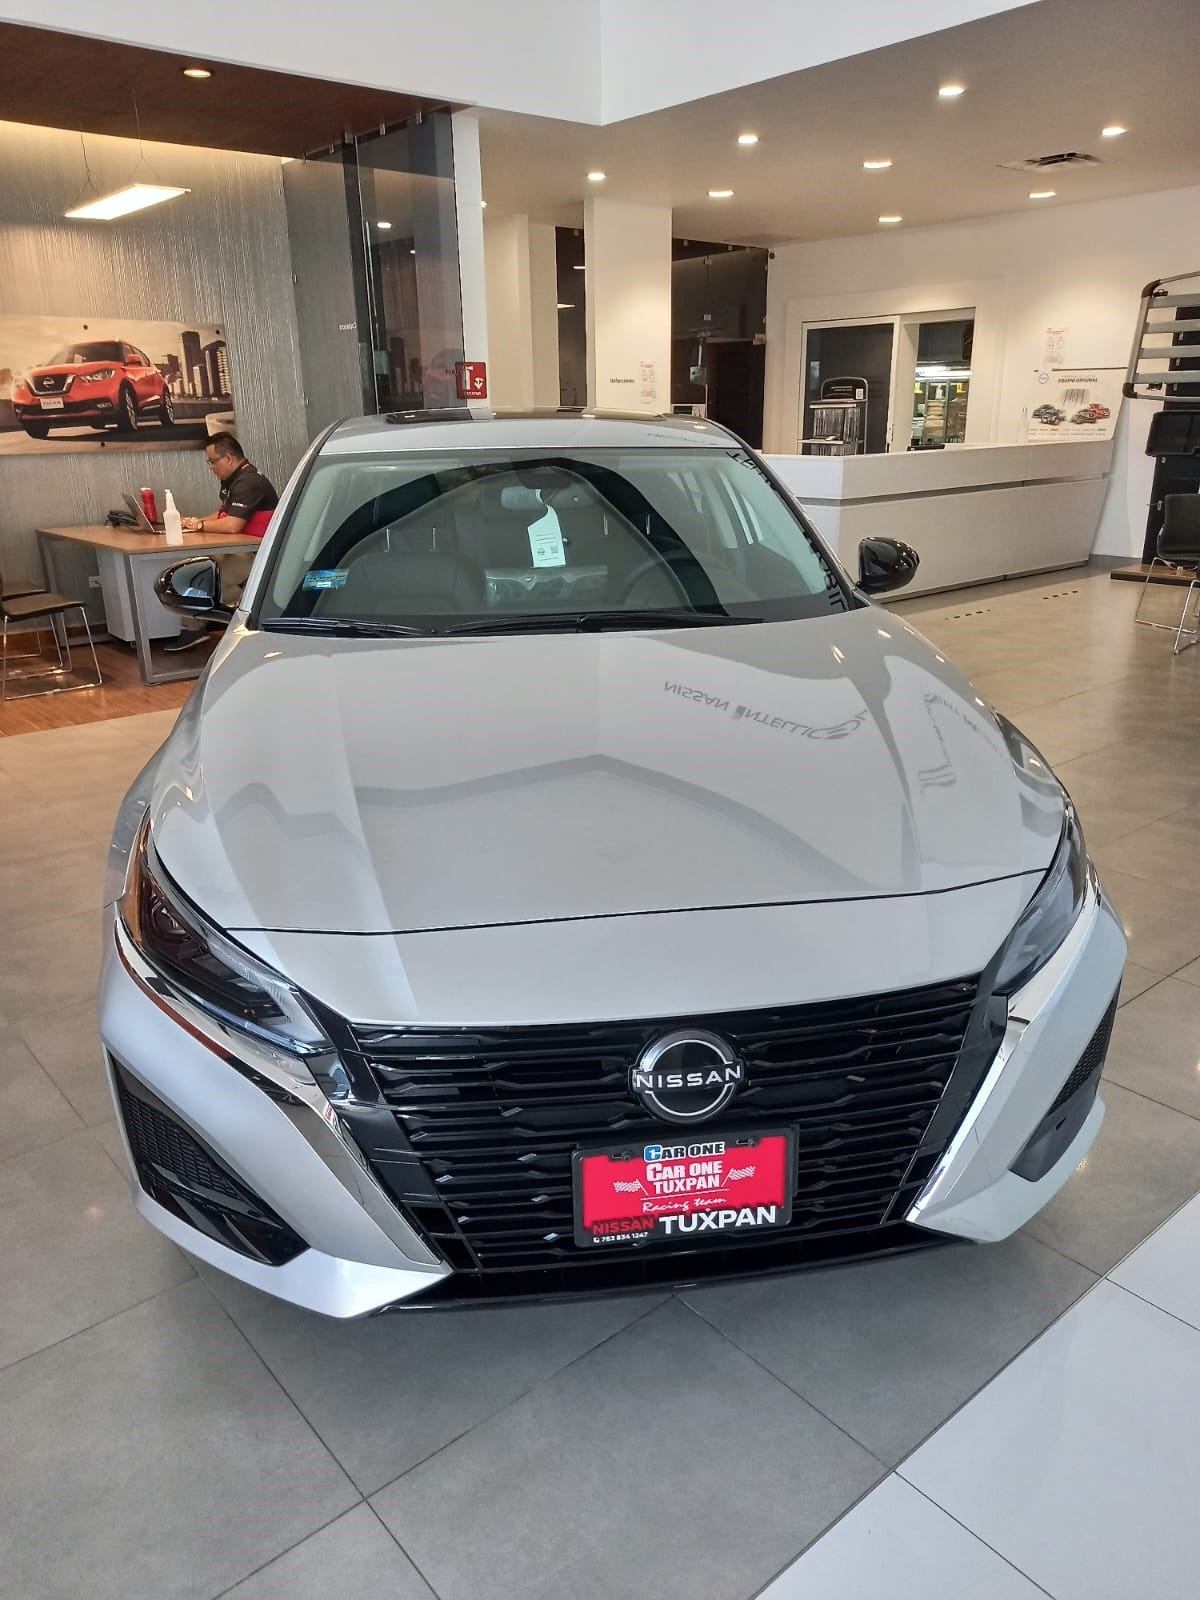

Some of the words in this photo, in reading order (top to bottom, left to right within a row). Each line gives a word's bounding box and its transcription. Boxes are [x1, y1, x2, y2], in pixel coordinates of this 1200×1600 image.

[635, 1065, 741, 1088] NISSAN
[644, 1145, 686, 1162] CAR
[688, 1142, 725, 1157] ONE
[646, 1163, 685, 1182] CAR
[689, 1161, 723, 1177] ONE
[653, 1174, 720, 1195] TUXPAN
[643, 1201, 690, 1213] Racing
[693, 1197, 727, 1207] team
[592, 1219, 654, 1235] NISSAN
[659, 1205, 776, 1234] TUXPAN
